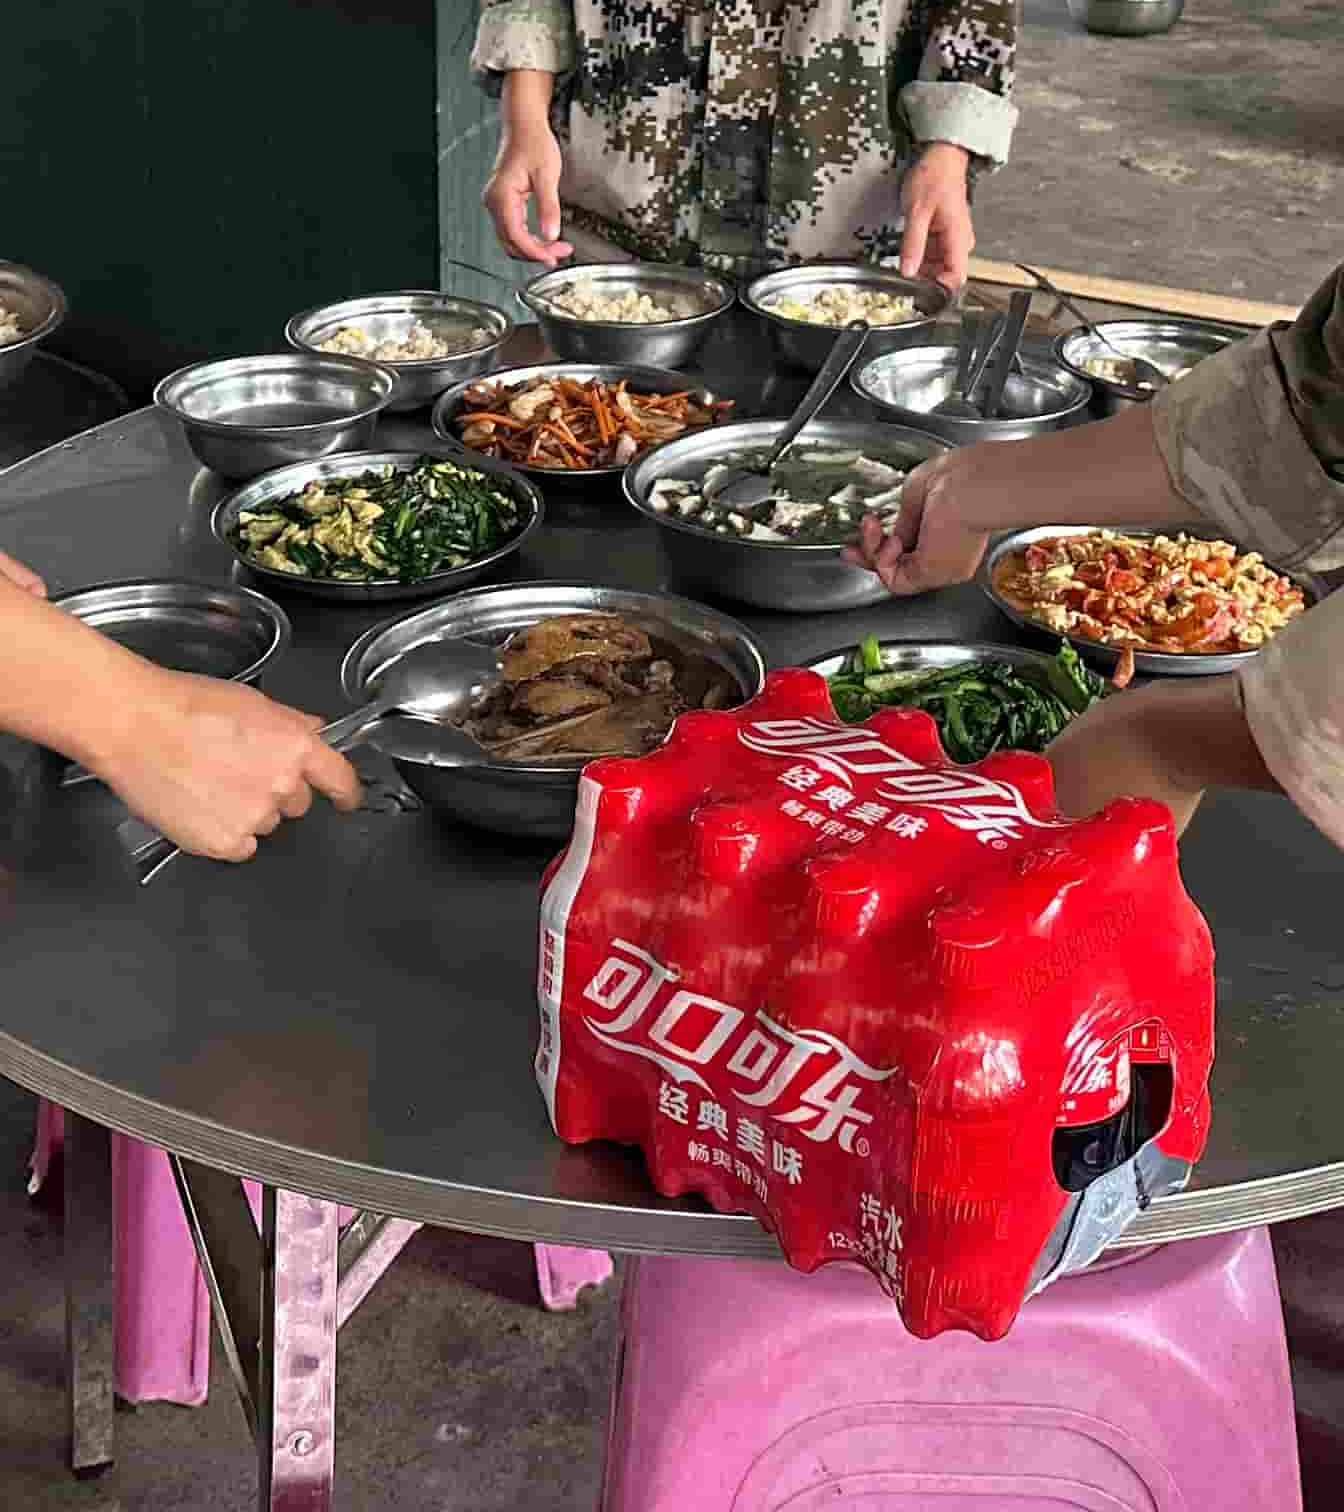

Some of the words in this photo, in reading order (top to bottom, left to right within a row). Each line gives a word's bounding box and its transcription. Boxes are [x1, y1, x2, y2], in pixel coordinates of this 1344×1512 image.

[737, 716, 1058, 842] 可口可乐
[777, 764, 929, 840] 经典美味
[582, 937, 899, 1154] 可口可乐
[658, 1079, 804, 1185] 经典美味
[859, 1191, 904, 1251] 汽水
